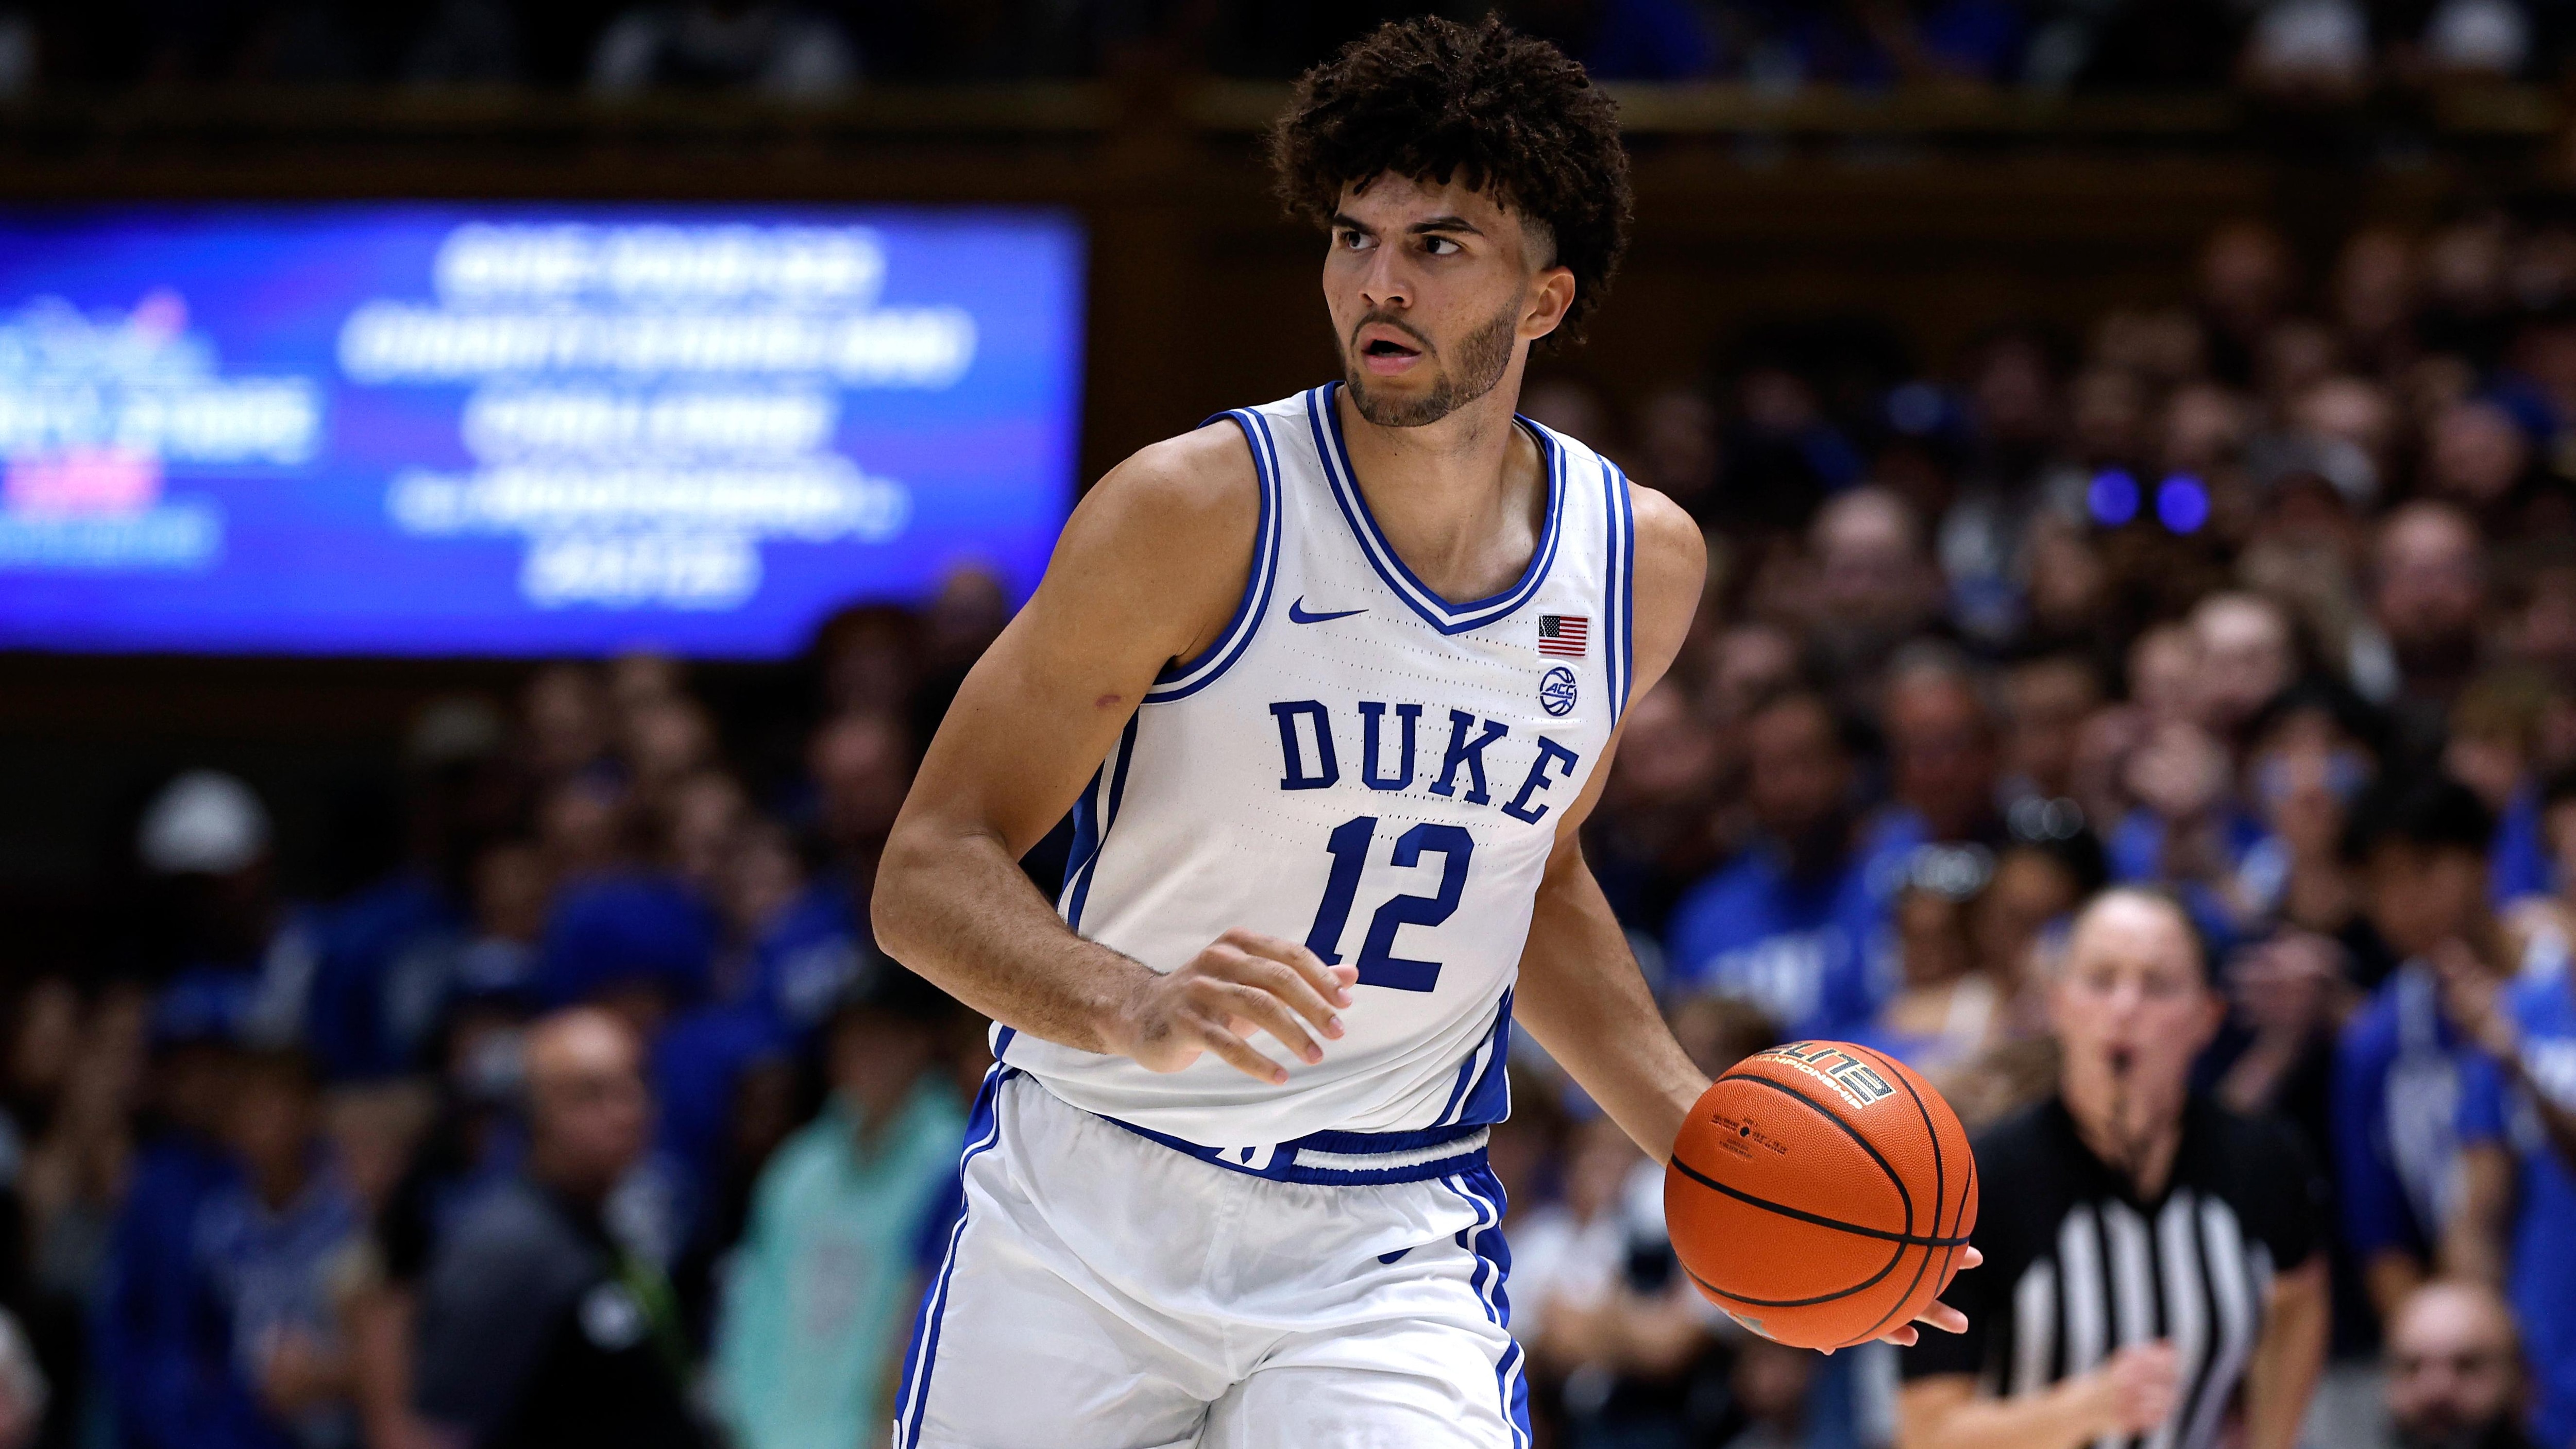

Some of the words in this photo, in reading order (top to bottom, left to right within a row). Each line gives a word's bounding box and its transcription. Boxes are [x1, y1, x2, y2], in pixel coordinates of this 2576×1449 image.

[1545, 683, 1577, 697] ACC
[1269, 699, 1580, 825] DUKE
[1304, 815, 1475, 992] 12
[1748, 1055, 1863, 1109] AMPIONSHIP
